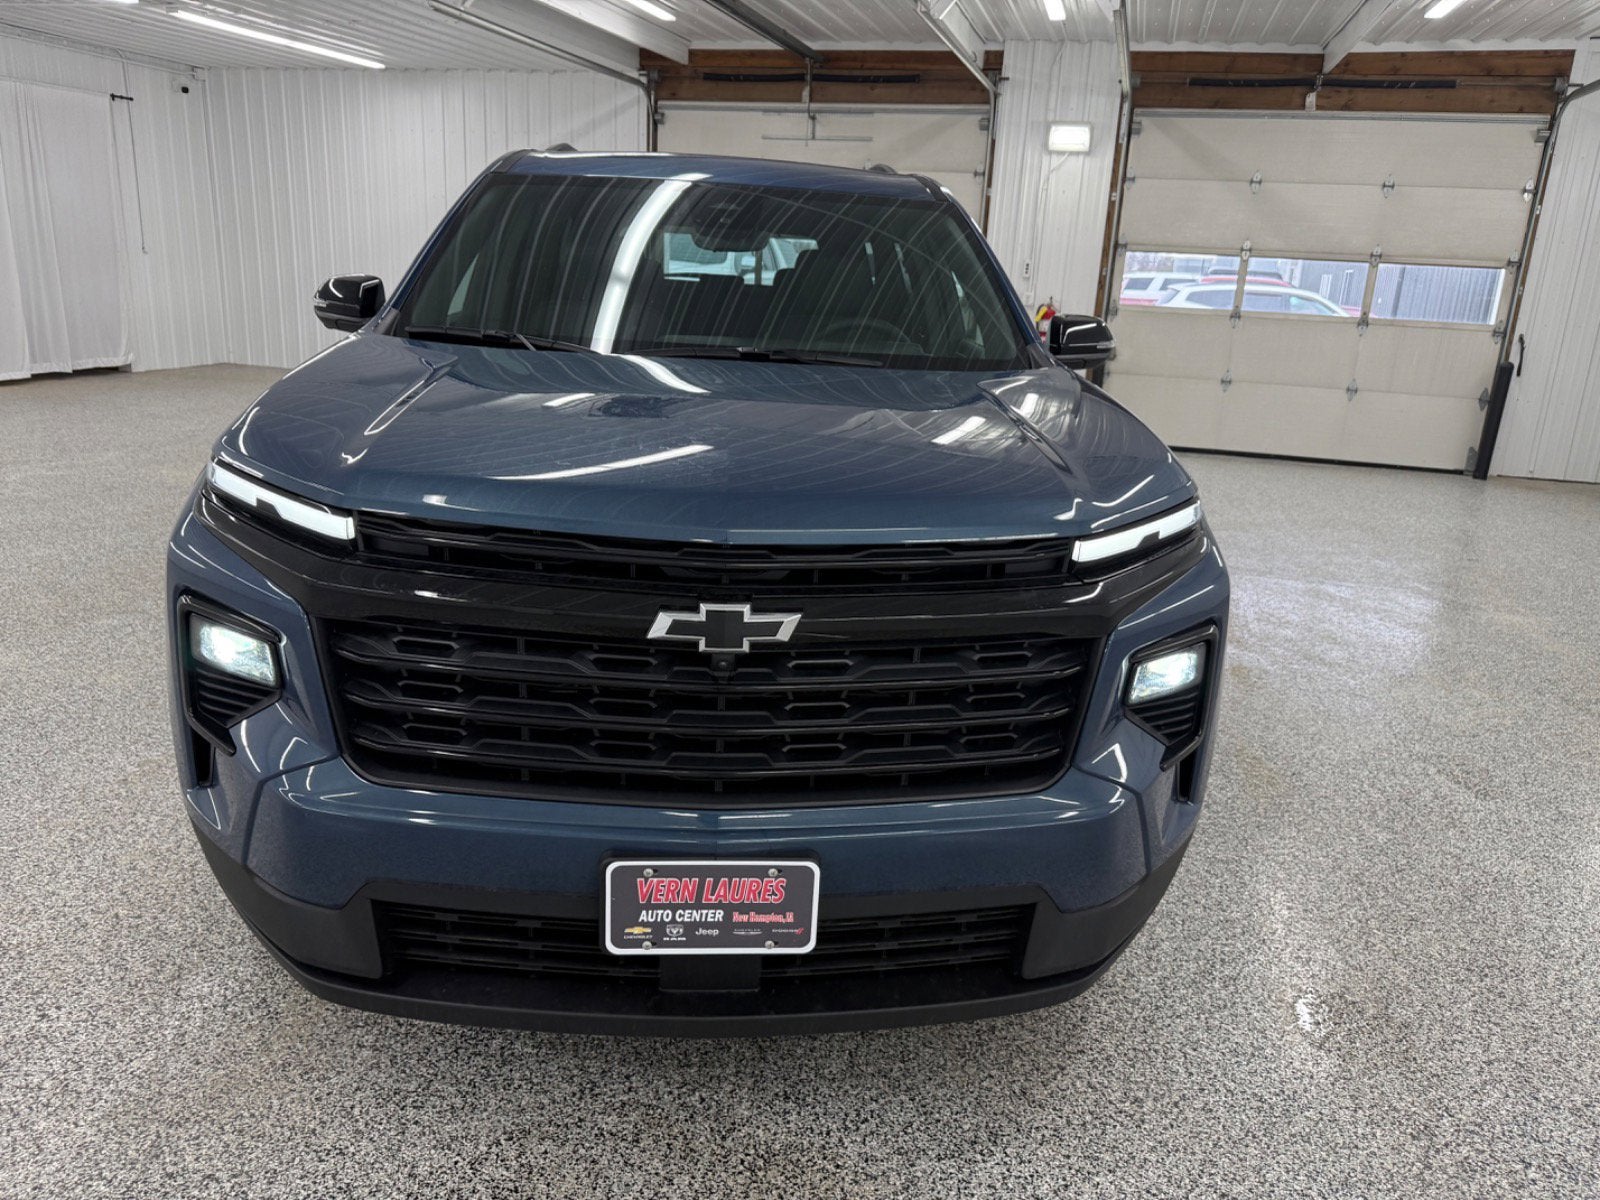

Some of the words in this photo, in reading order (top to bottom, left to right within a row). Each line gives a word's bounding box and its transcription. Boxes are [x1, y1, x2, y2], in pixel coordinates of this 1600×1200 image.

[637, 877, 699, 904] VERN
[702, 877, 787, 904] LAURES
[638, 909, 672, 923] AUTO
[675, 909, 725, 923] CENTER
[733, 911, 749, 923] New
[695, 927, 720, 937] Jeep
